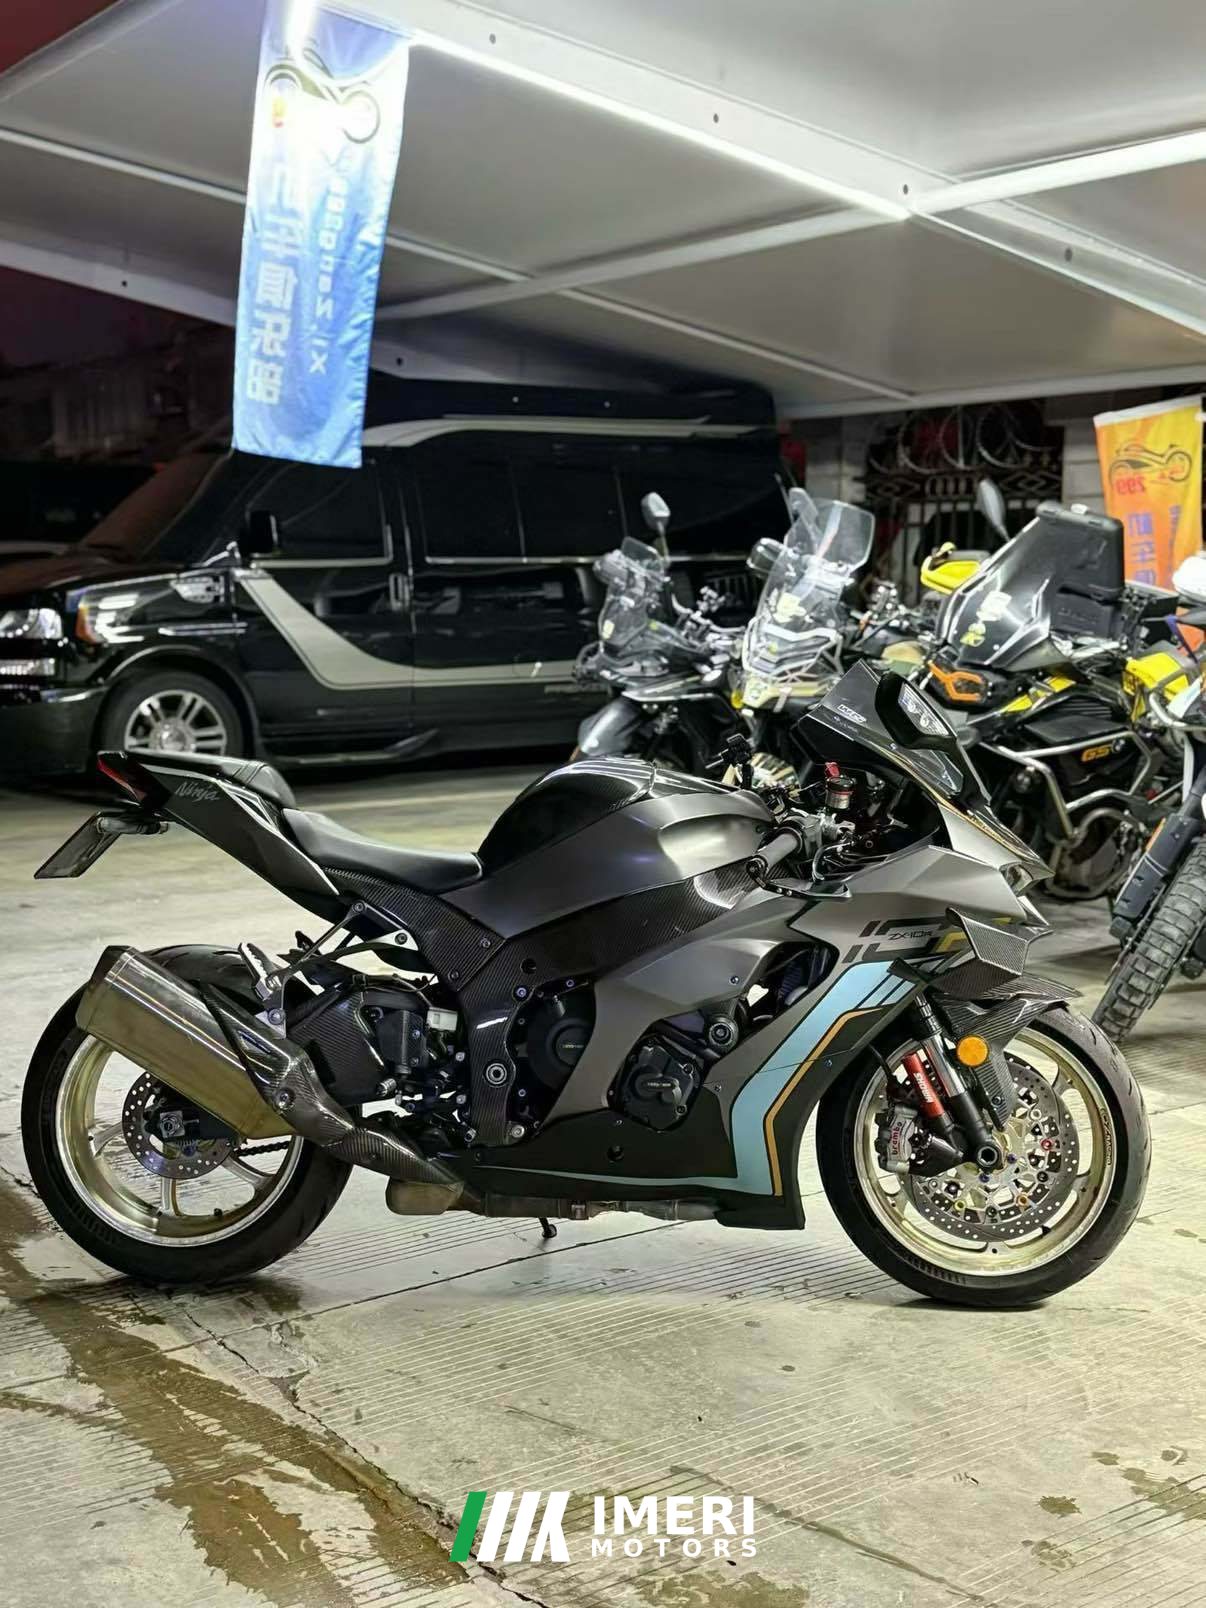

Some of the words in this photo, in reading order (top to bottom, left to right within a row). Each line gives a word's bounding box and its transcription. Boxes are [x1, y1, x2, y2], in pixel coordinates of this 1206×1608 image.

[1081, 743, 1111, 762] GS
[175, 781, 220, 802] Ninja
[913, 1072, 935, 1103] SHOWA
